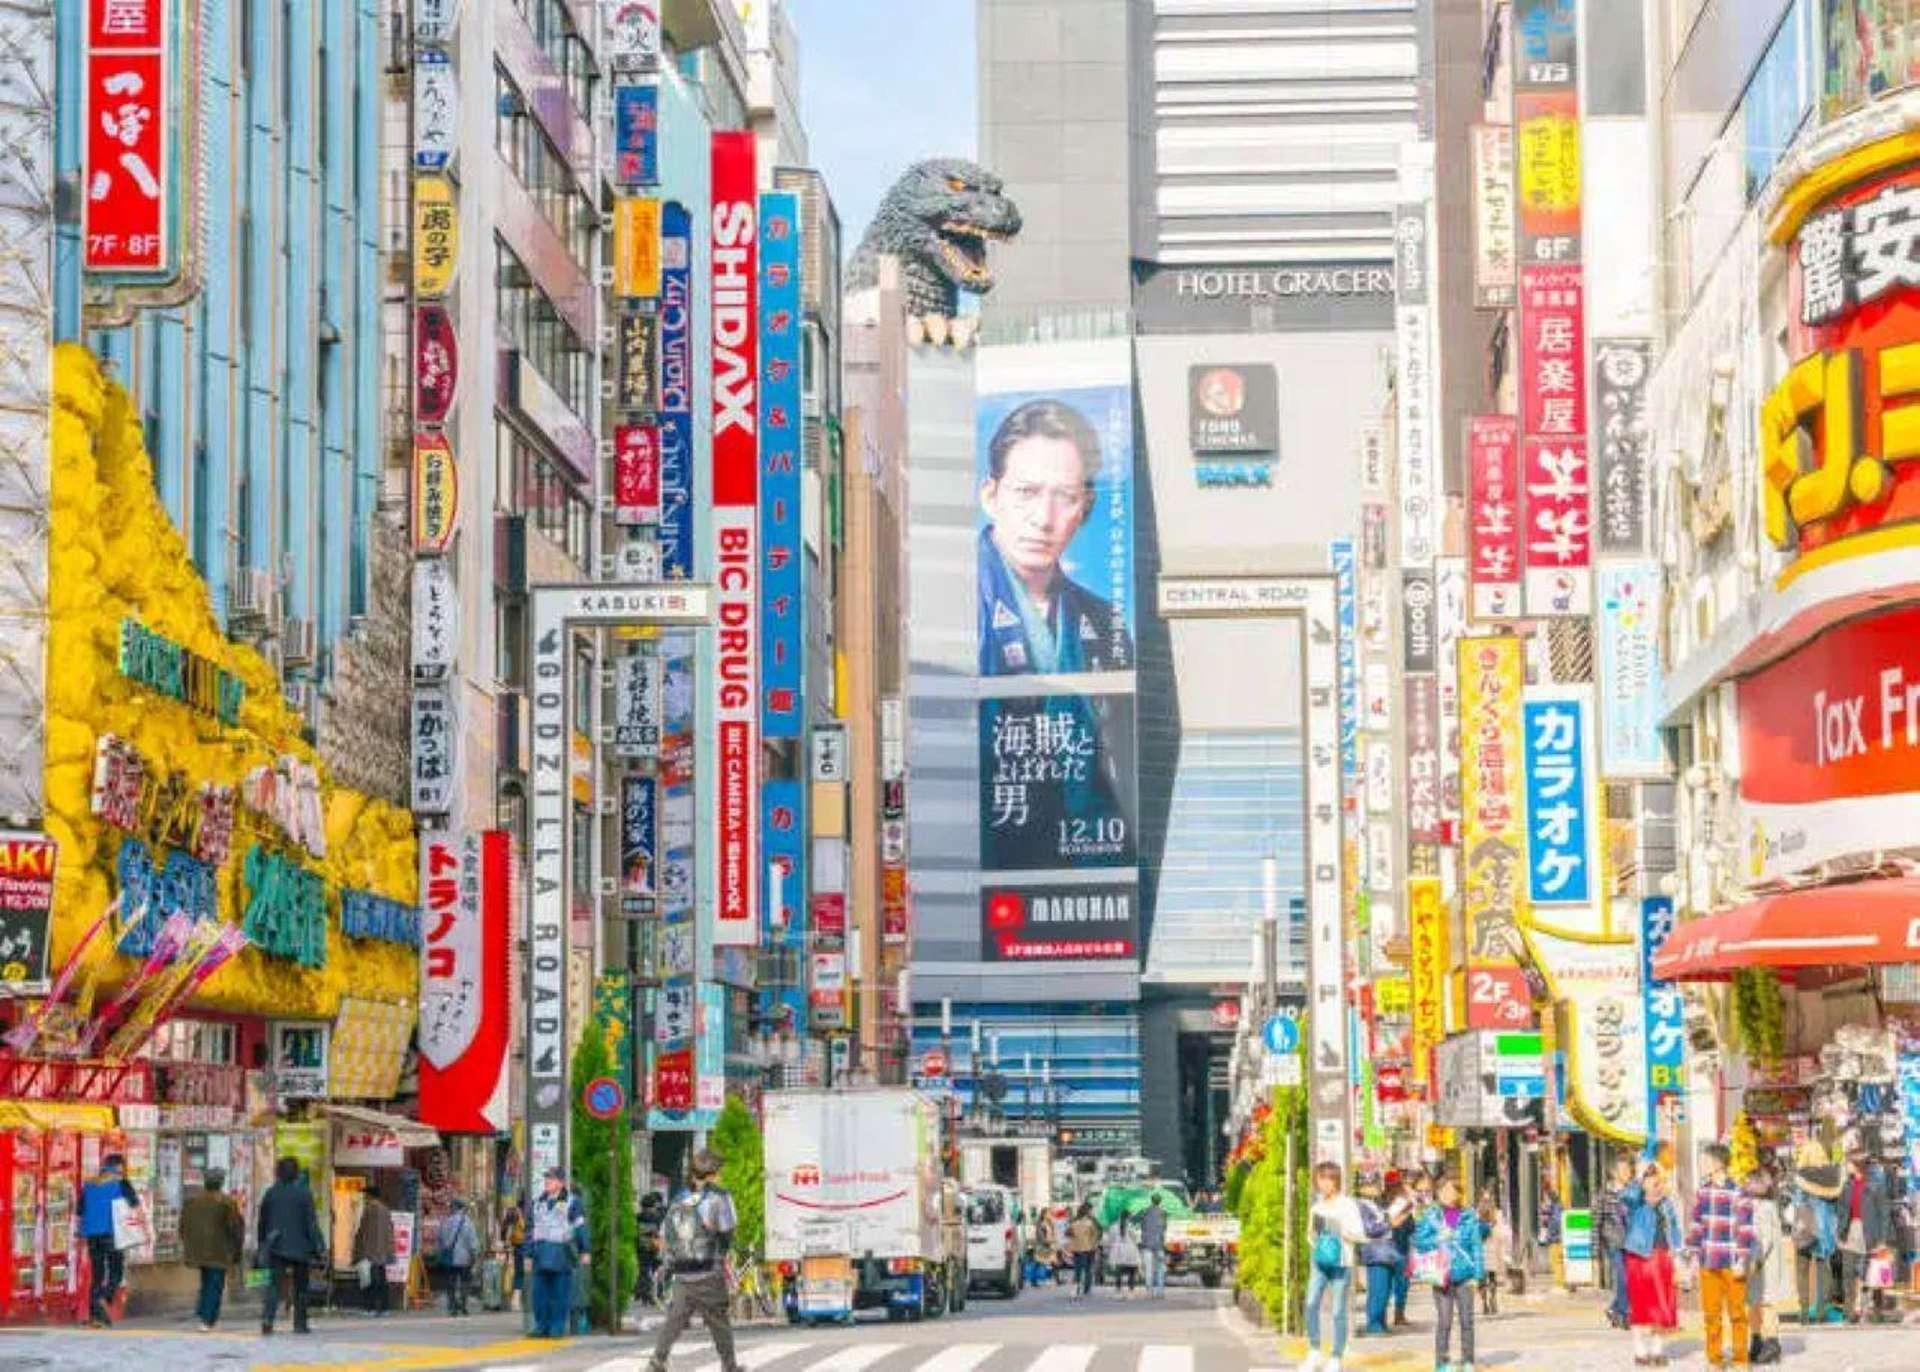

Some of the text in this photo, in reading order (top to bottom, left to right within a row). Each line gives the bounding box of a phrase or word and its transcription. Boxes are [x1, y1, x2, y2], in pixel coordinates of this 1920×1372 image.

[88, 72, 159, 200] つぼ八
[1535, 237, 1572, 260] 6F
[1178, 269, 1397, 297] HOTEL GRACERY
[713, 202, 755, 435] SHIDAX
[1166, 587, 1310, 603] CENTRAL ROAD
[718, 528, 749, 709] BIC DRUG
[993, 712, 1095, 757] 海賊と
[1813, 689, 1868, 768] Tax
[993, 757, 1087, 783] よばれた
[727, 759, 742, 832] CAMERA
[991, 783, 1030, 827] 男
[1534, 705, 1582, 893] カラオケ
[536, 661, 561, 1027] GODZILLA ROAD
[1059, 817, 1125, 843] 12.10
[426, 844, 459, 979] トラノコ
[1032, 896, 1129, 922] MARUHAN
[1472, 973, 1511, 1002] 2F
